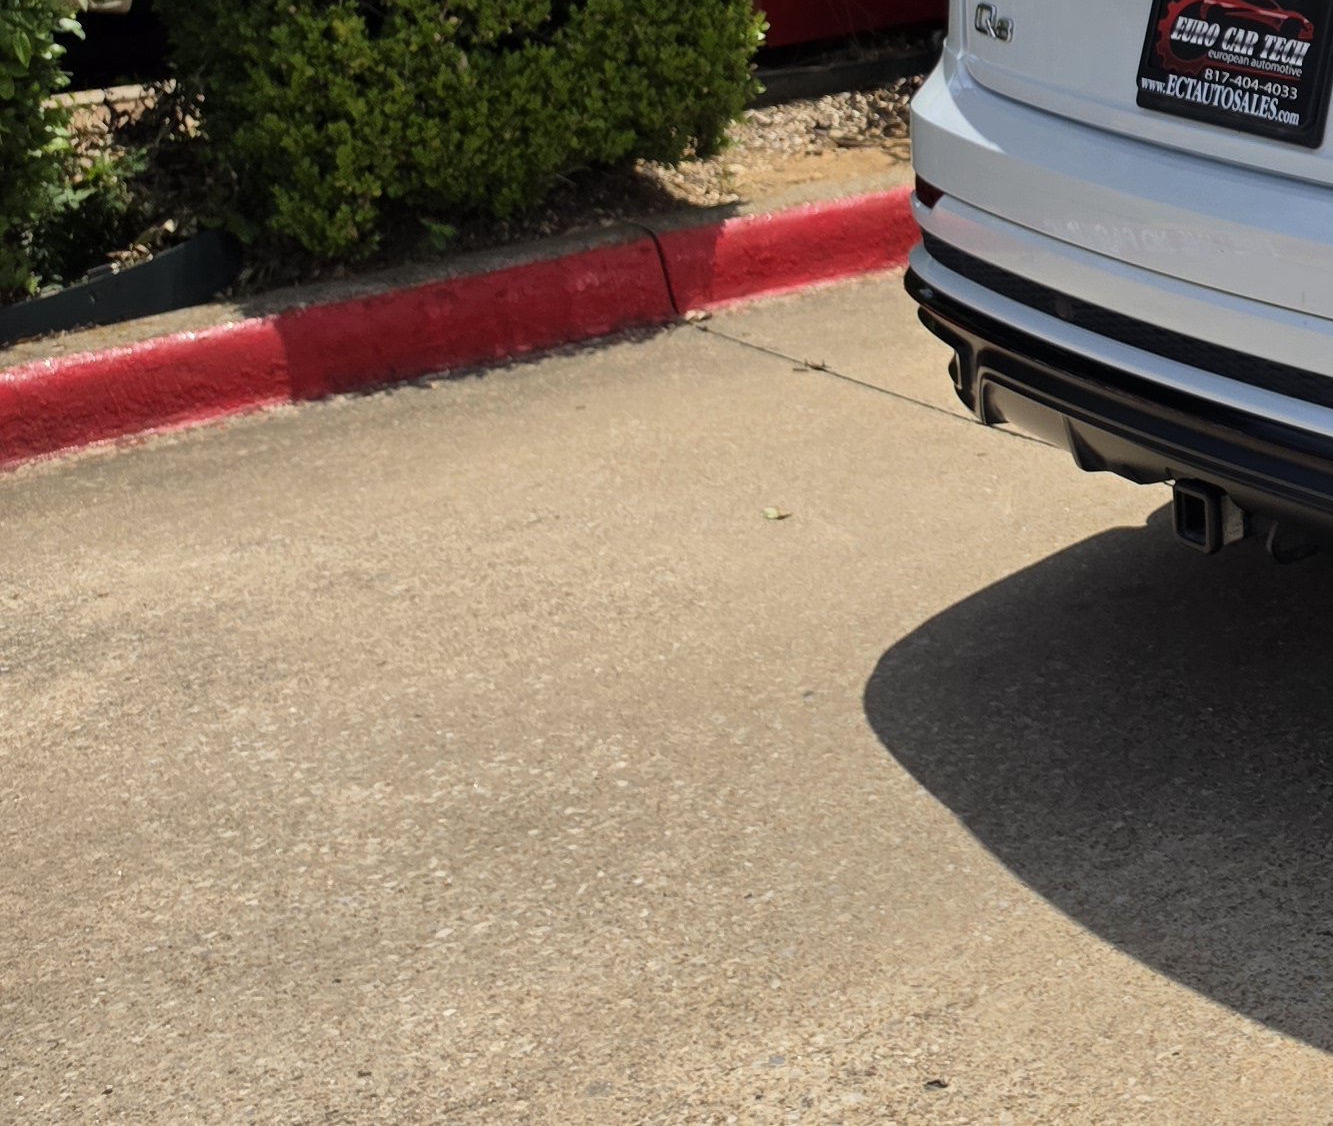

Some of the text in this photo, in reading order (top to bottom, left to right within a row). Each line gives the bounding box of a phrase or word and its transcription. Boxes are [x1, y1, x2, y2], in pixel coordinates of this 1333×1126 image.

[974, 2, 1014, 43] Q8
[1170, 16, 1311, 67] EURO CAR TECH
[1208, 48, 1303, 78] european automotive
[1141, 74, 1301, 126] www.ECTAUTOSALES.com
[1204, 68, 1299, 100] 817-404-4033
